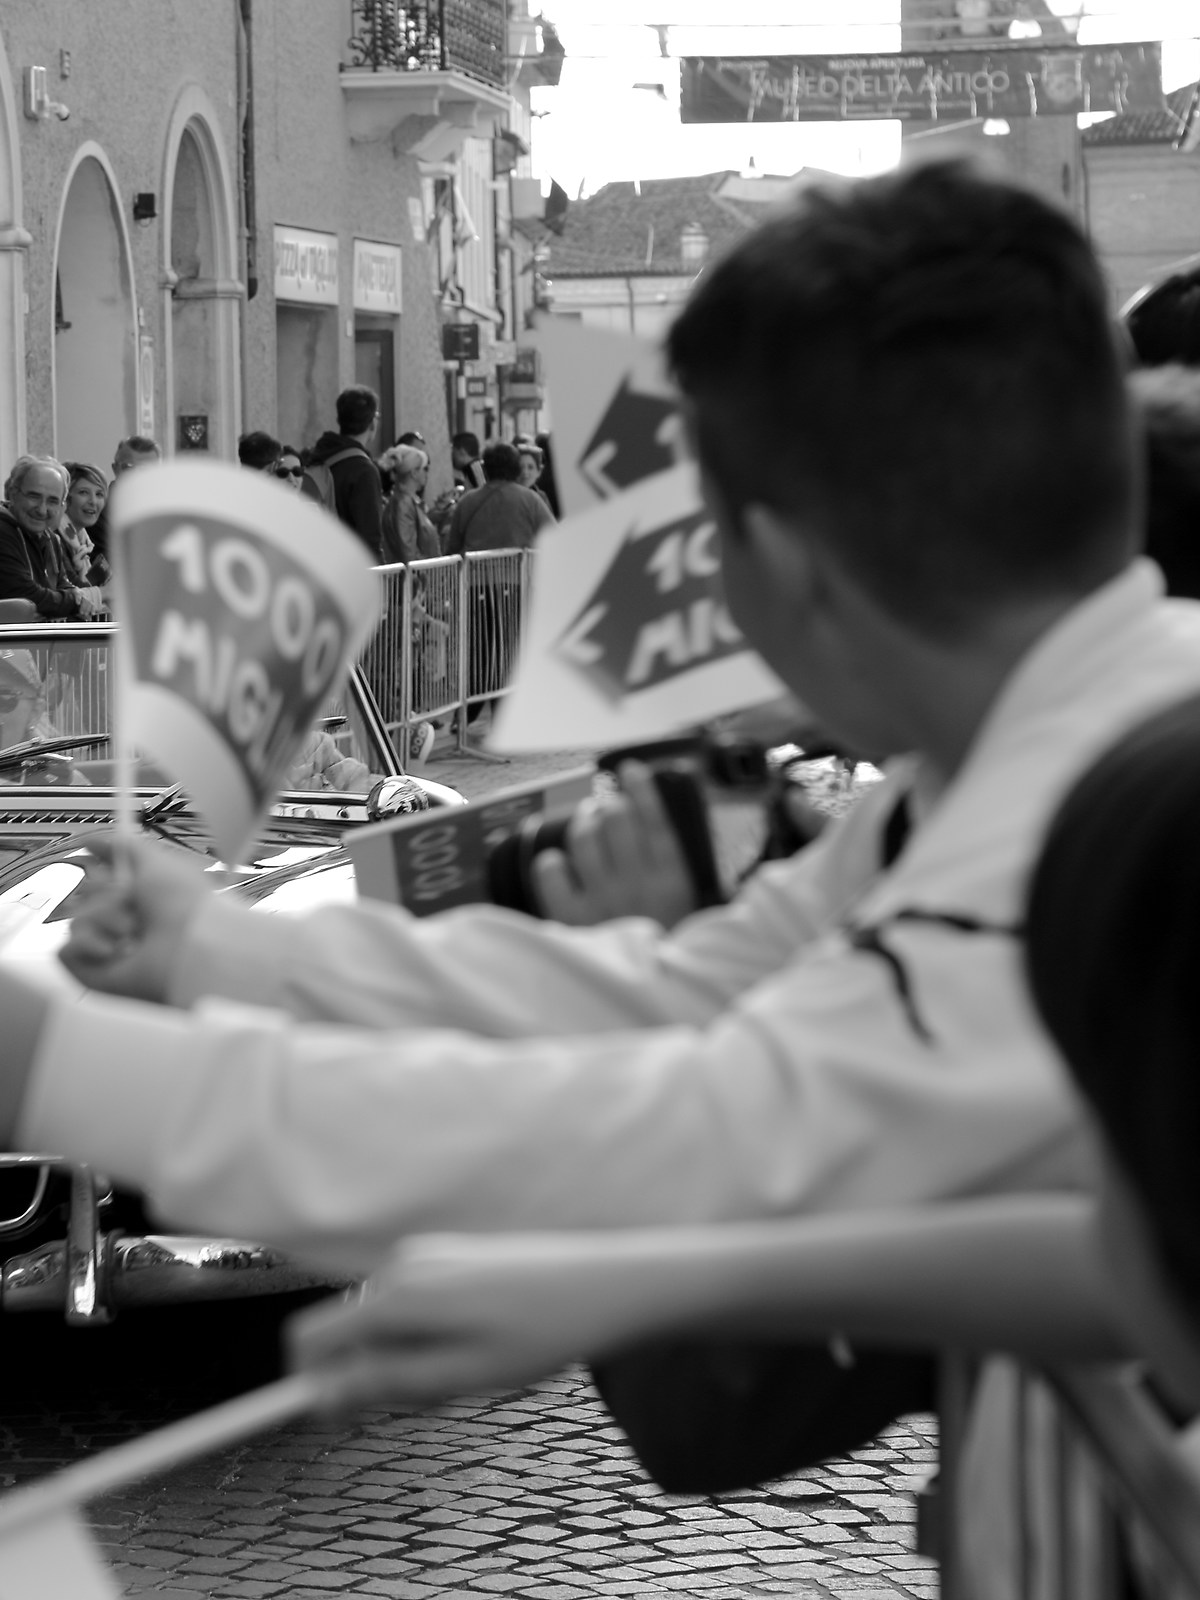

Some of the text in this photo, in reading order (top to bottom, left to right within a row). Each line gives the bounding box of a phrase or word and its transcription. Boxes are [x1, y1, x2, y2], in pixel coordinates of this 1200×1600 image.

[841, 73, 913, 97] DELTA
[916, 69, 1010, 95] ANTICO
[159, 522, 343, 697] 1000
